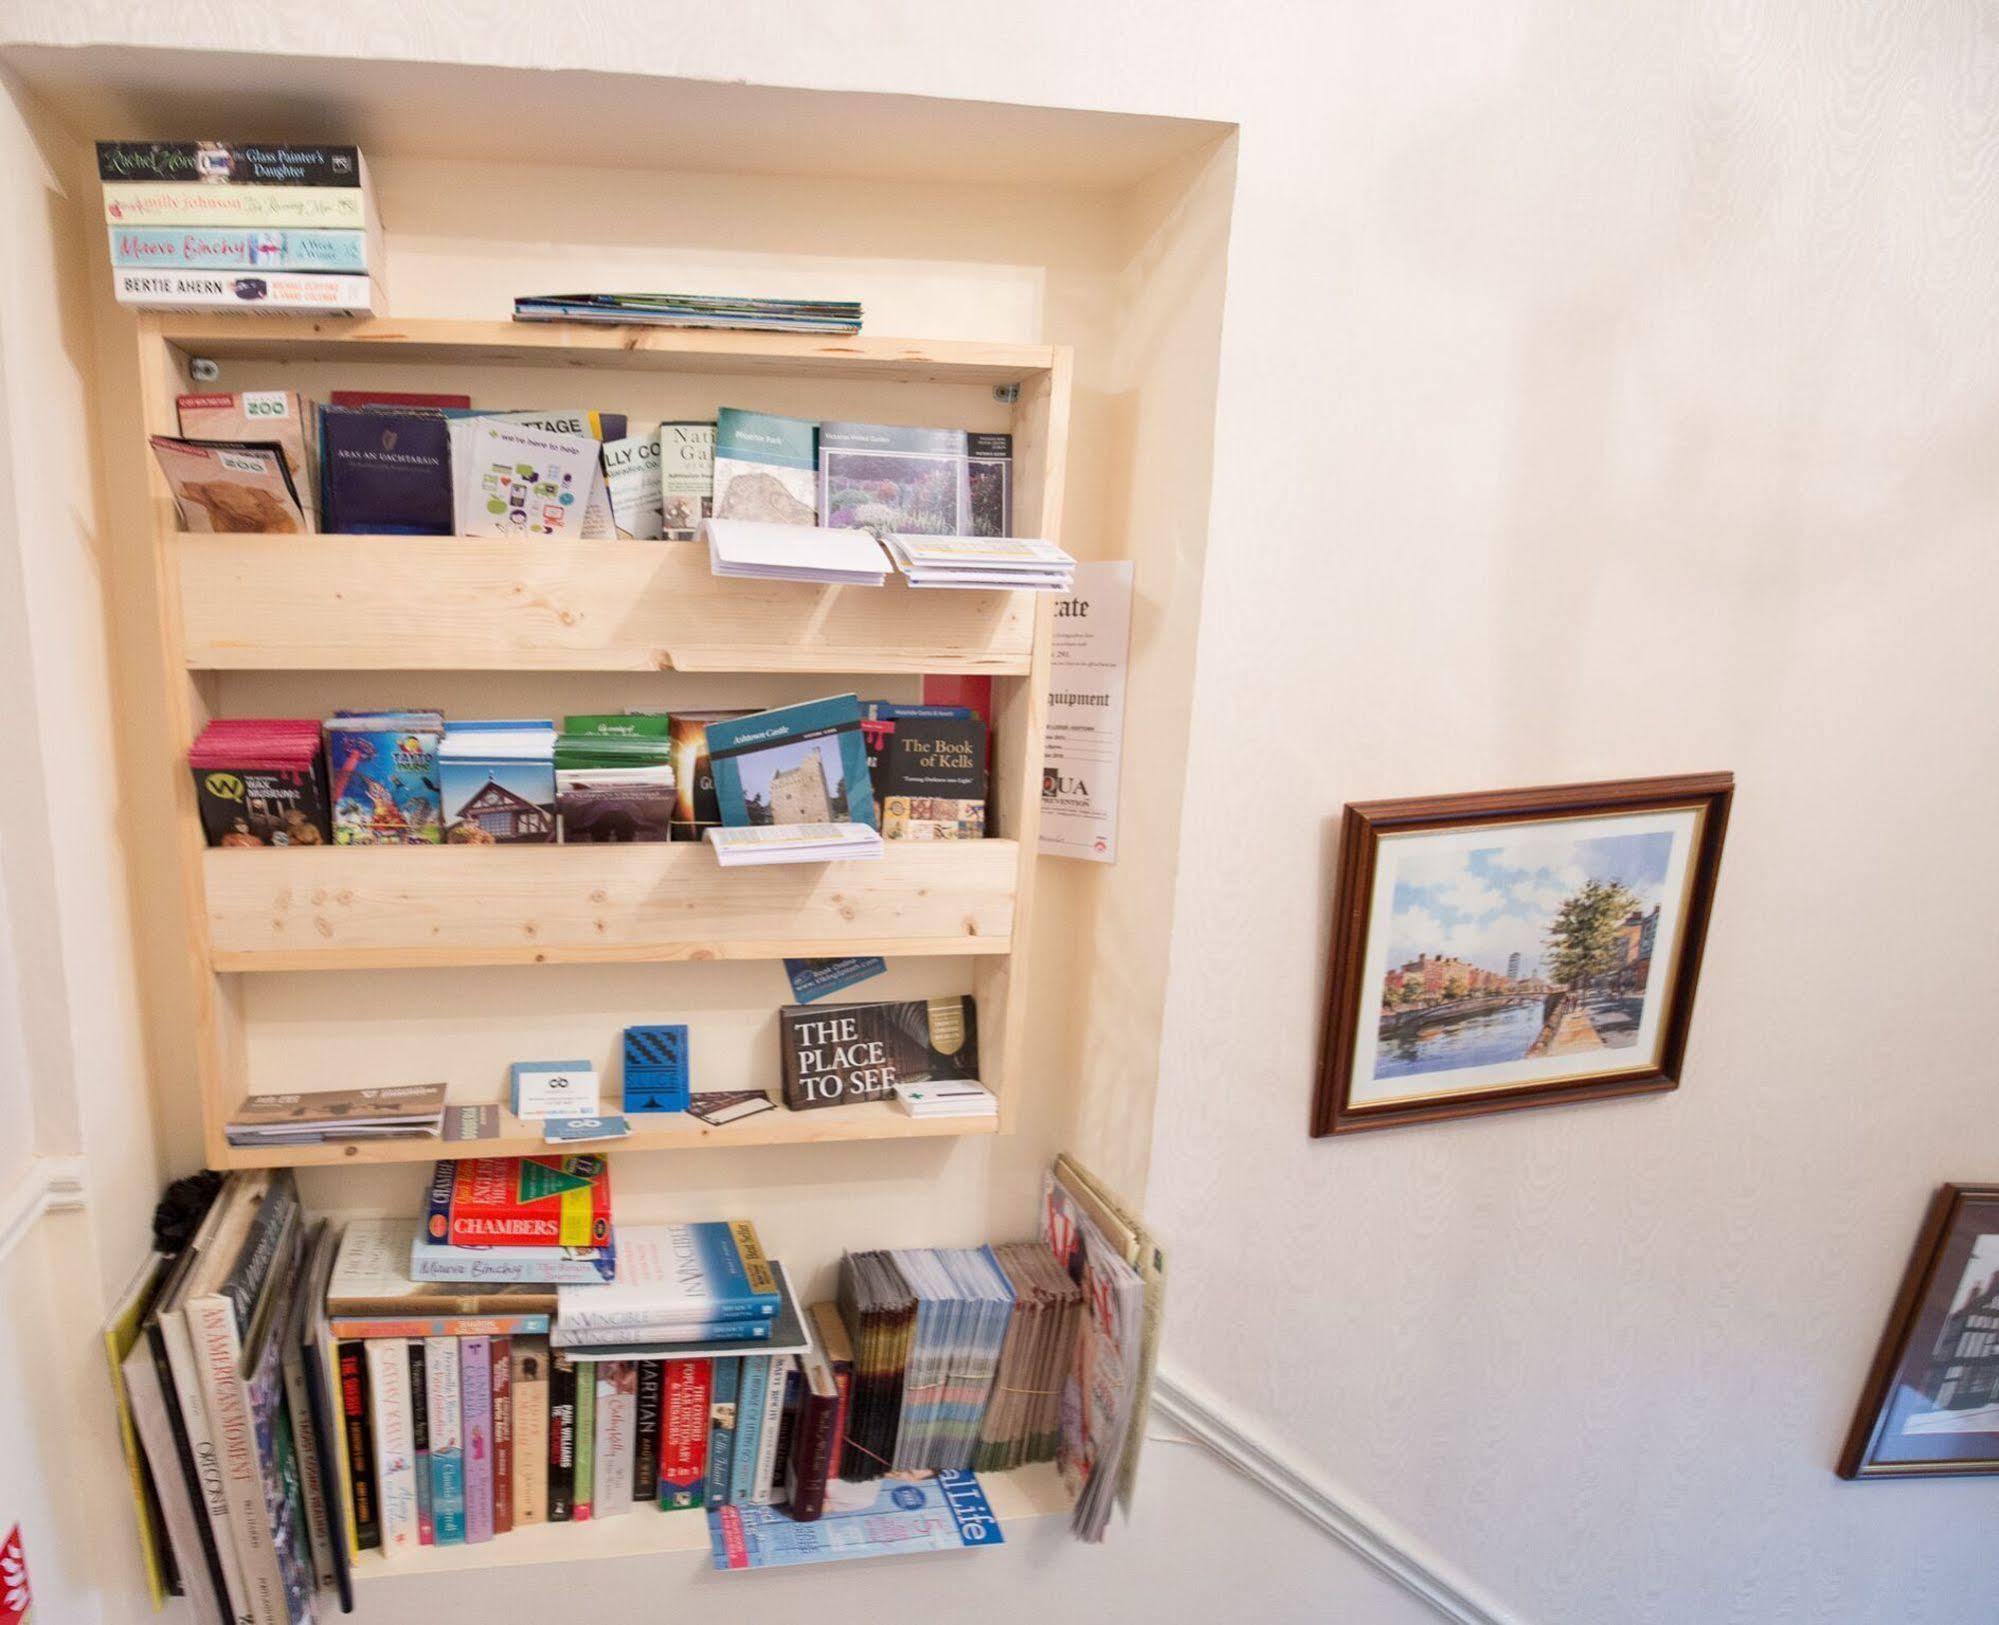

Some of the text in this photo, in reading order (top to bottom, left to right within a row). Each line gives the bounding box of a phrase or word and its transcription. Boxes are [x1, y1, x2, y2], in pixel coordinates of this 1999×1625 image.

[246, 148, 276, 163] Glass
[278, 149, 325, 165] Painter's
[254, 163, 305, 181] Daughter
[119, 234, 246, 261] Maeve Binchy
[124, 277, 223, 295] BERTIE AHERN
[766, 435, 782, 445] Park
[765, 725, 790, 738] Castle
[901, 738, 974, 755] The Book
[920, 753, 974, 769] of Kells
[794, 1017, 859, 1047] THE
[798, 1041, 887, 1075] PLACE
[799, 1067, 896, 1102] TO SEE
[454, 1217, 559, 1236] CHAMBERS
[419, 1260, 524, 1281] Maeve Binchy
[206, 1331, 241, 1413] AMERICAN
[639, 1360, 657, 1433] MARTIAN
[669, 1391, 681, 1446] THESAURUS
[678, 1362, 695, 1463] POPULAR DICTIONARY
[692, 1384, 704, 1442] THE OXFORD
[221, 1415, 252, 1482] MOMENT
[560, 1404, 573, 1468] PAUL WILLIAMS
[713, 1432, 730, 1487] Ellis Island
